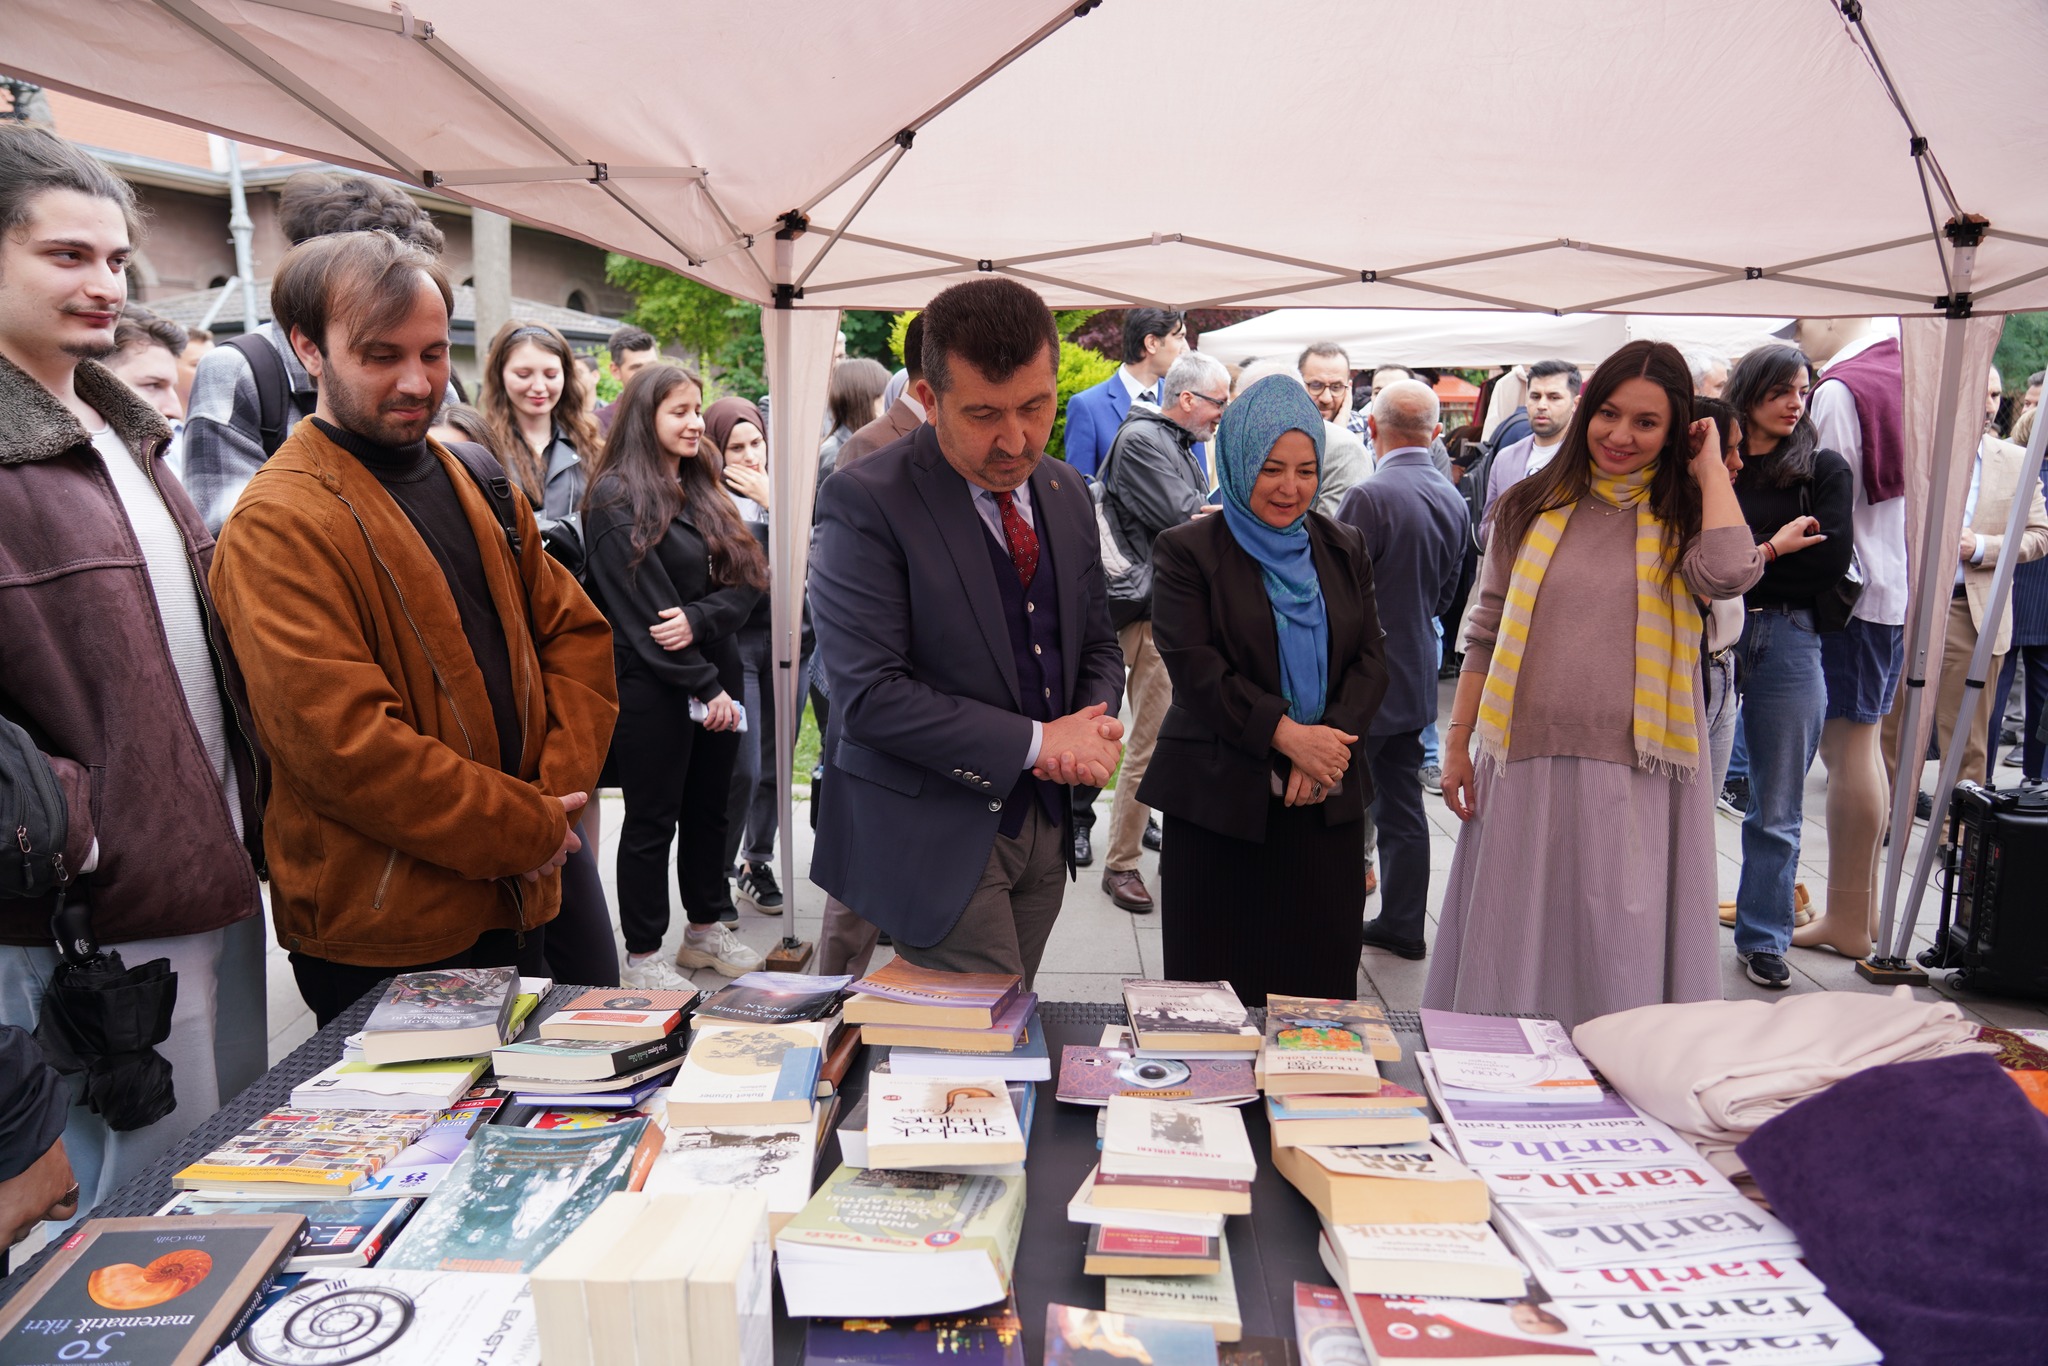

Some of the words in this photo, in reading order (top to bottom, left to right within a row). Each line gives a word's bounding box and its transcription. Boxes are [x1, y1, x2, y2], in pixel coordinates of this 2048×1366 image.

[892, 1116, 987, 1128] Holmes
[1516, 1121, 1582, 1131] Kadına
[1588, 1119, 1646, 1129] Kadın
[890, 1126, 1006, 1139] Sherlock
[1508, 1138, 1674, 1162] tarih
[1535, 1169, 1709, 1196] tarih
[827, 1216, 920, 1230] ANADOLU
[1584, 1212, 1765, 1252] tarih
[183, 1235, 206, 1243] Tony
[1342, 1224, 1488, 1243] Atomik
[1599, 1260, 1786, 1292] tarih
[1617, 1297, 1812, 1330] tarih
[21, 1319, 73, 1335] fikri
[74, 1315, 196, 1334] matematik
[58, 1331, 126, 1360] 50
[1640, 1334, 1839, 1366] tarih
